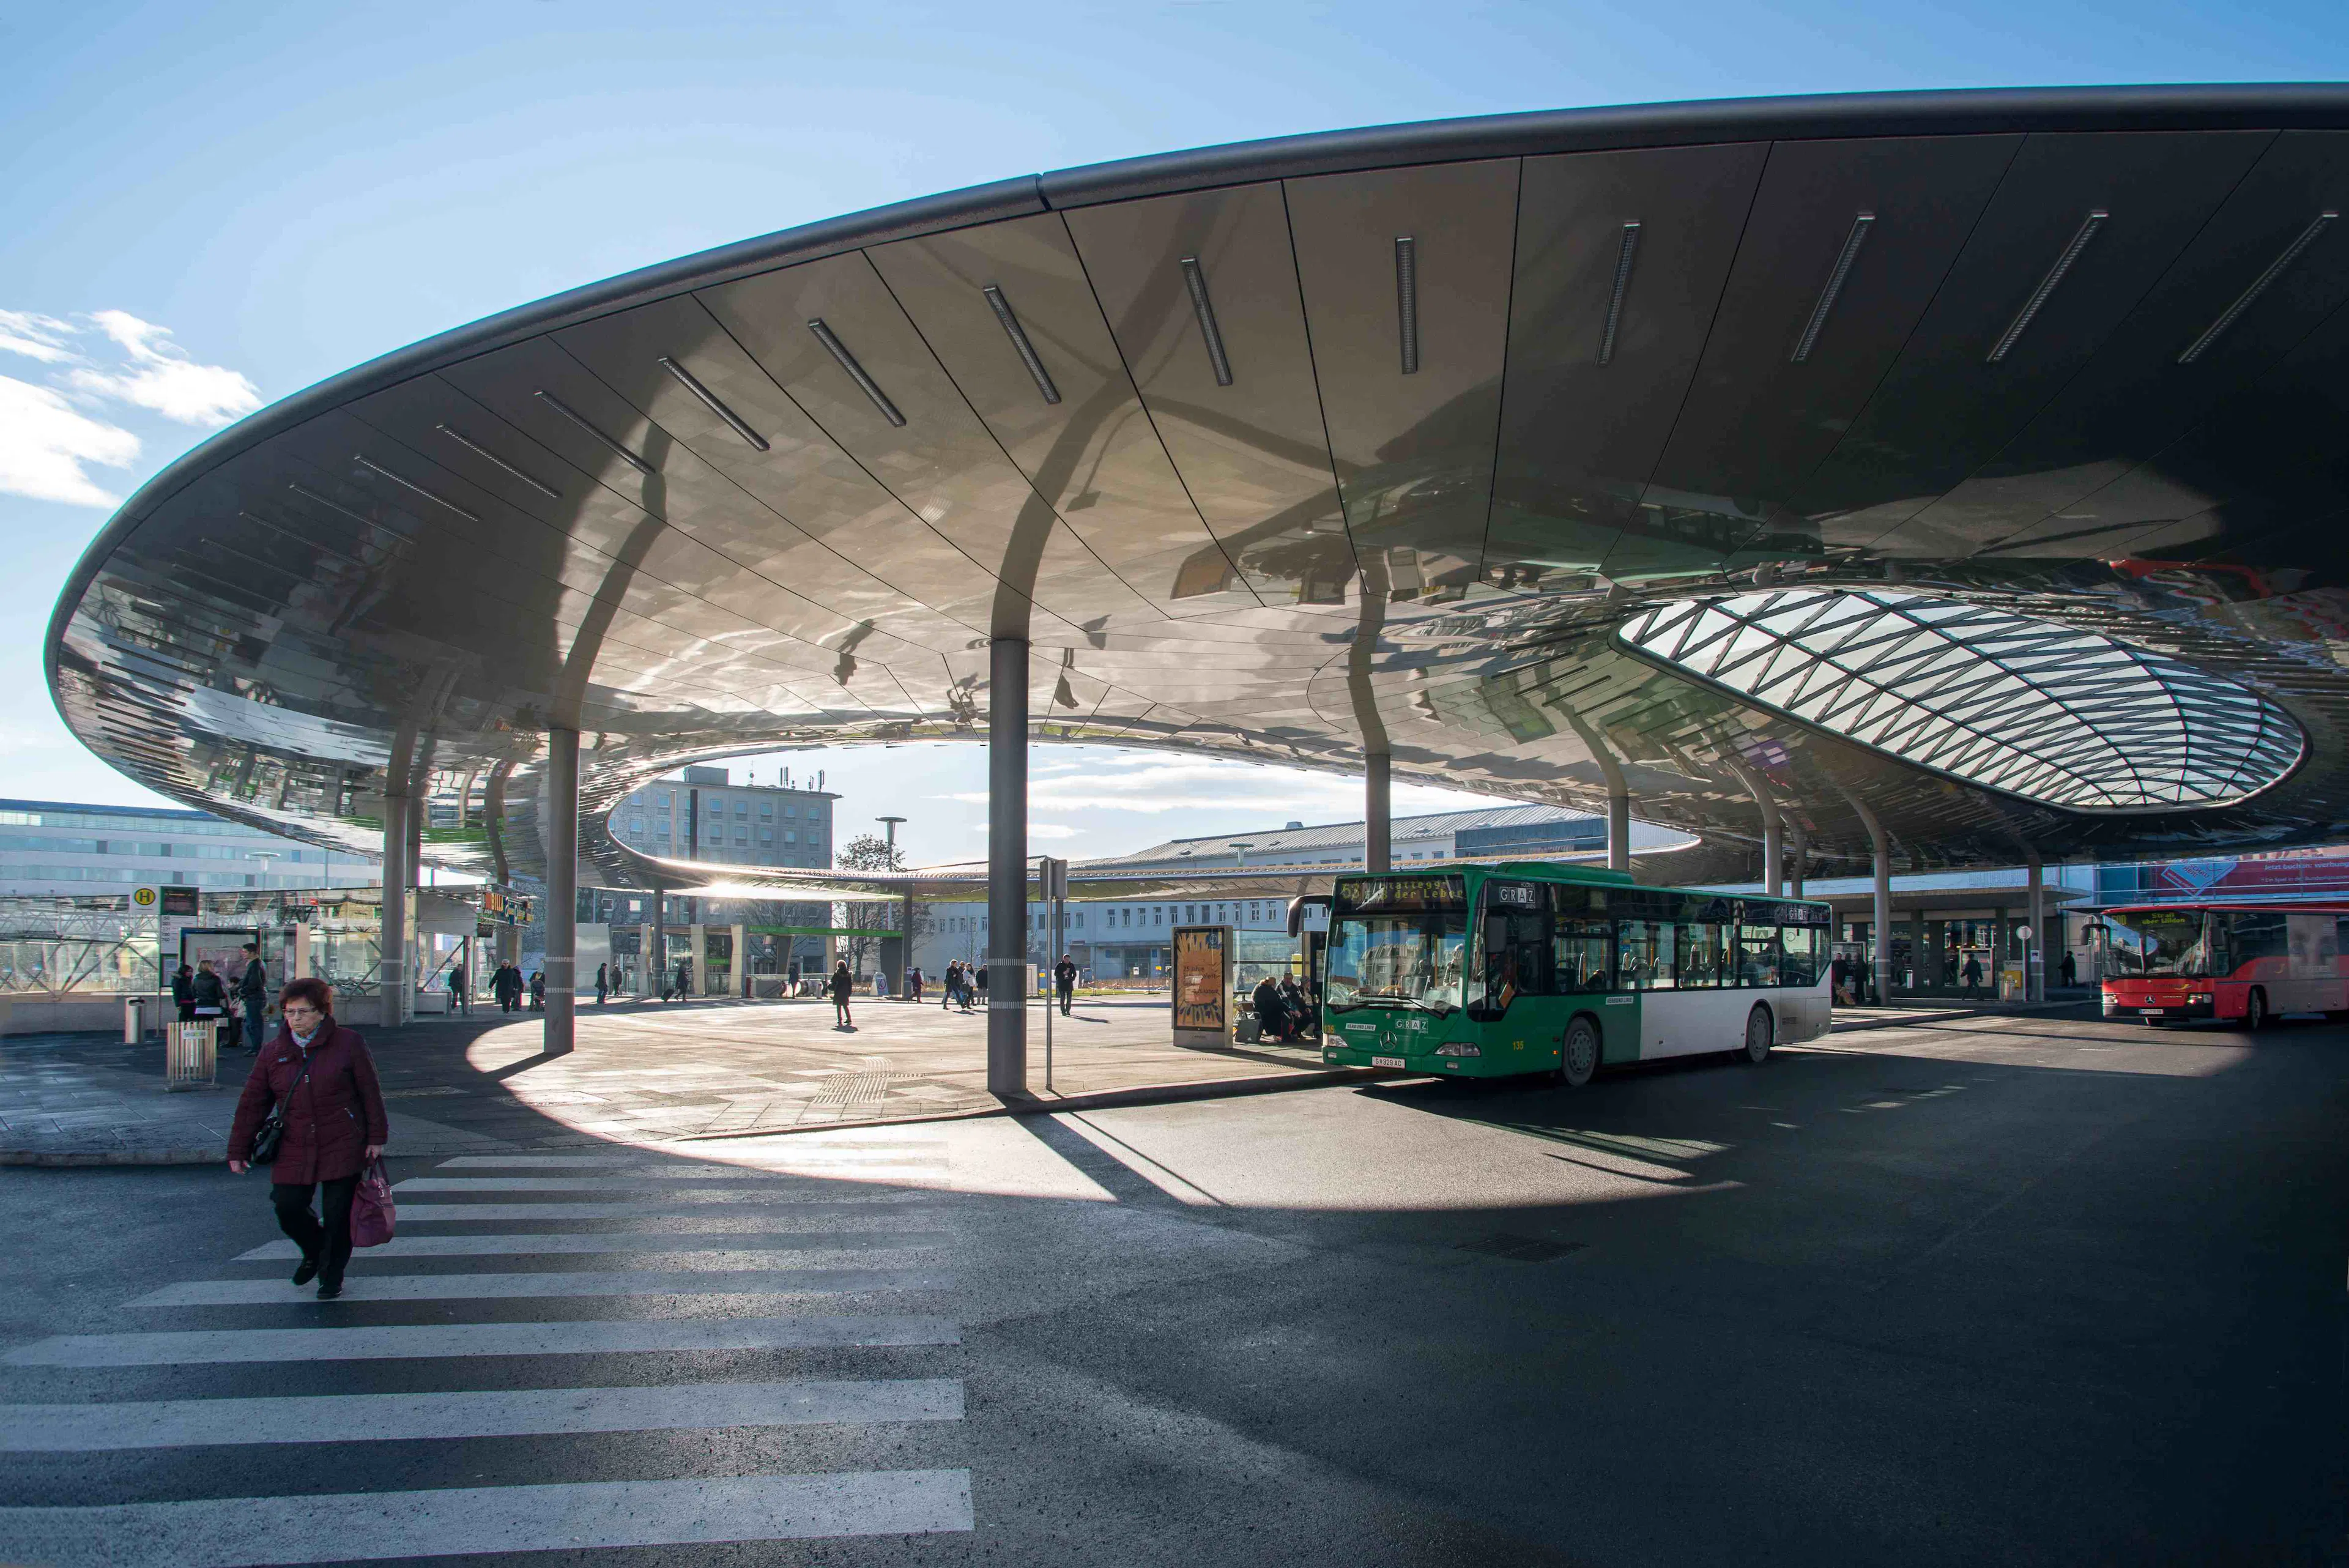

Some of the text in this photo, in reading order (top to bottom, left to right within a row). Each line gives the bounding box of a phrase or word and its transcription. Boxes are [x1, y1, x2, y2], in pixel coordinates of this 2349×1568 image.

[1394, 889, 1416, 899] der
[1500, 888, 1534, 902] GRAZ
[1789, 908, 1807, 920] GRAZ
[1396, 1020, 1427, 1030] GRAZ
[1513, 1041, 1524, 1050] 135
